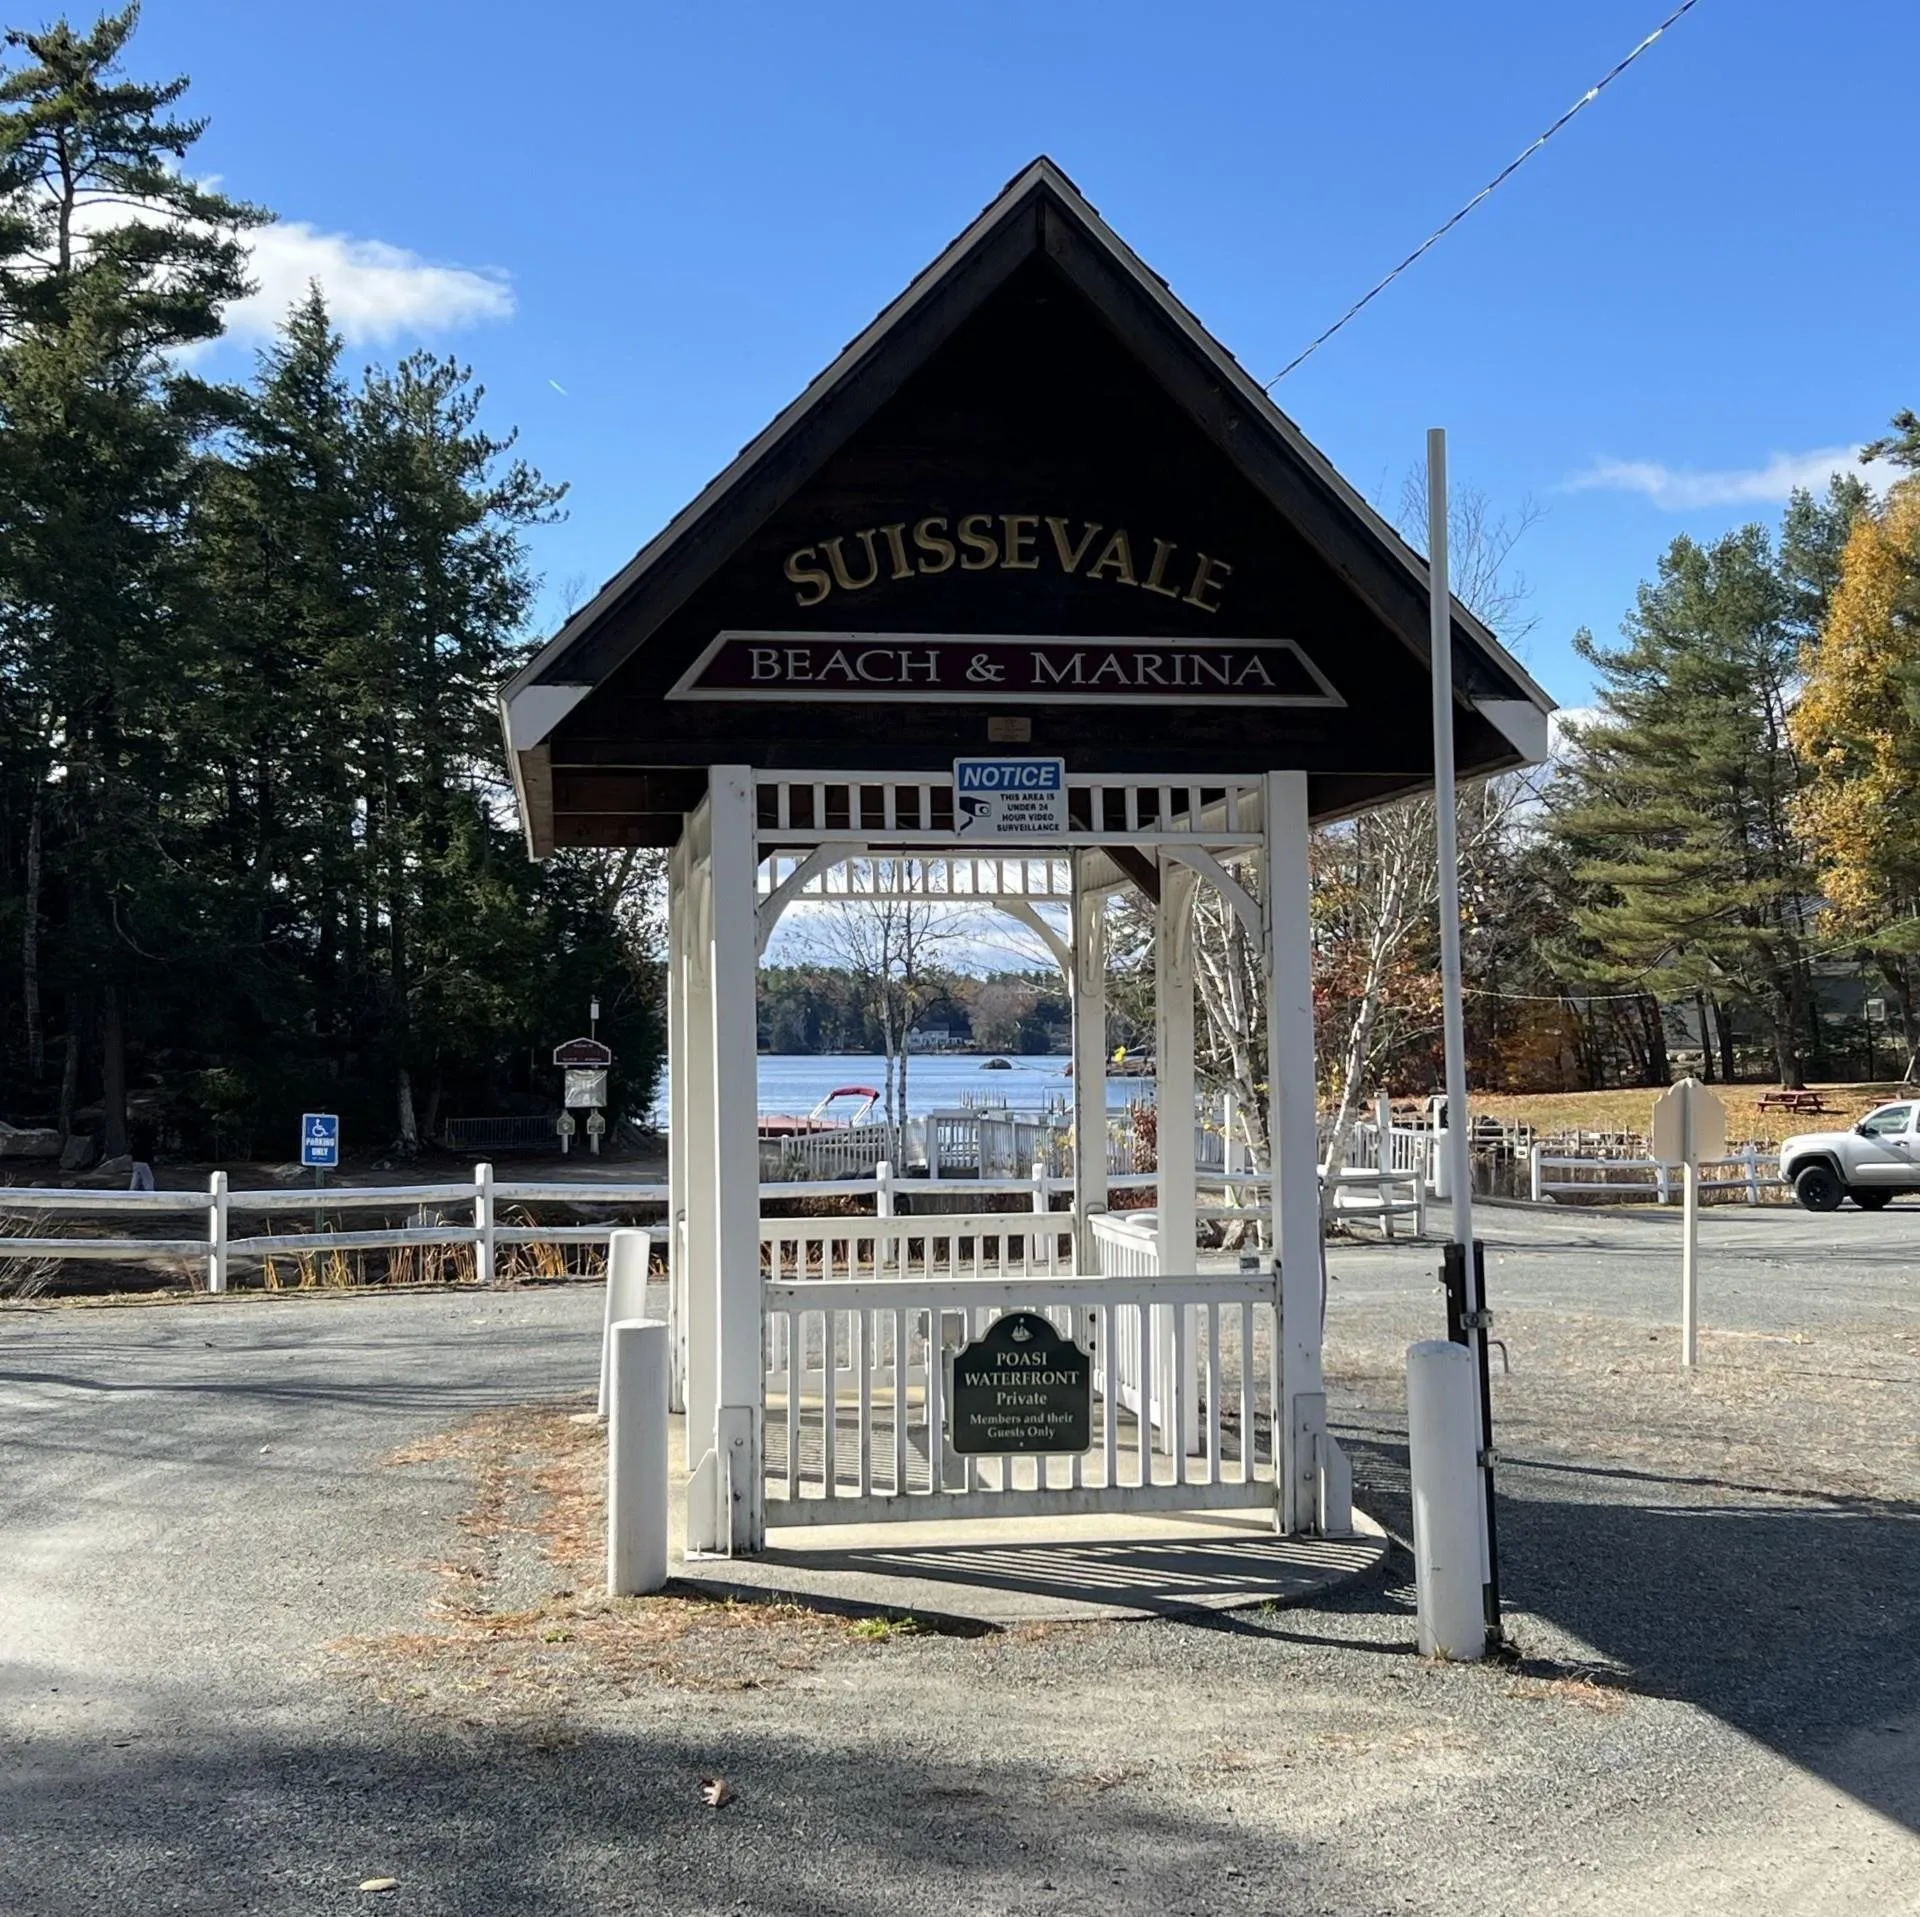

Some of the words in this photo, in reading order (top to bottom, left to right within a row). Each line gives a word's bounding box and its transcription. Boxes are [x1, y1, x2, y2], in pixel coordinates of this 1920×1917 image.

[783, 513, 1234, 613] SUISSEVALE
[749, 648, 942, 683] BEACH
[965, 652, 1006, 684] &
[1030, 651, 1277, 687] MARINA
[963, 766, 1056, 787] NOTICE
[1000, 794, 1020, 802] THIS
[1022, 793, 1044, 801] AREA
[1046, 793, 1055, 801] IS
[1007, 803, 1036, 811] UNDER
[1039, 803, 1049, 811] 24
[1002, 813, 1026, 822] HOUR
[1028, 813, 1054, 821] VIDEO
[996, 823, 1060, 832] SURVEILLANCE
[306, 1137, 334, 1146] PARKING
[996, 1351, 1047, 1366] POASI
[964, 1371, 1079, 1386] WATERFRONT
[996, 1391, 1047, 1405] Private
[969, 1414, 1022, 1425] Members
[1023, 1412, 1045, 1423] and
[1047, 1412, 1074, 1423] their
[987, 1427, 1025, 1438] Guests
[1027, 1426, 1056, 1439] Only
